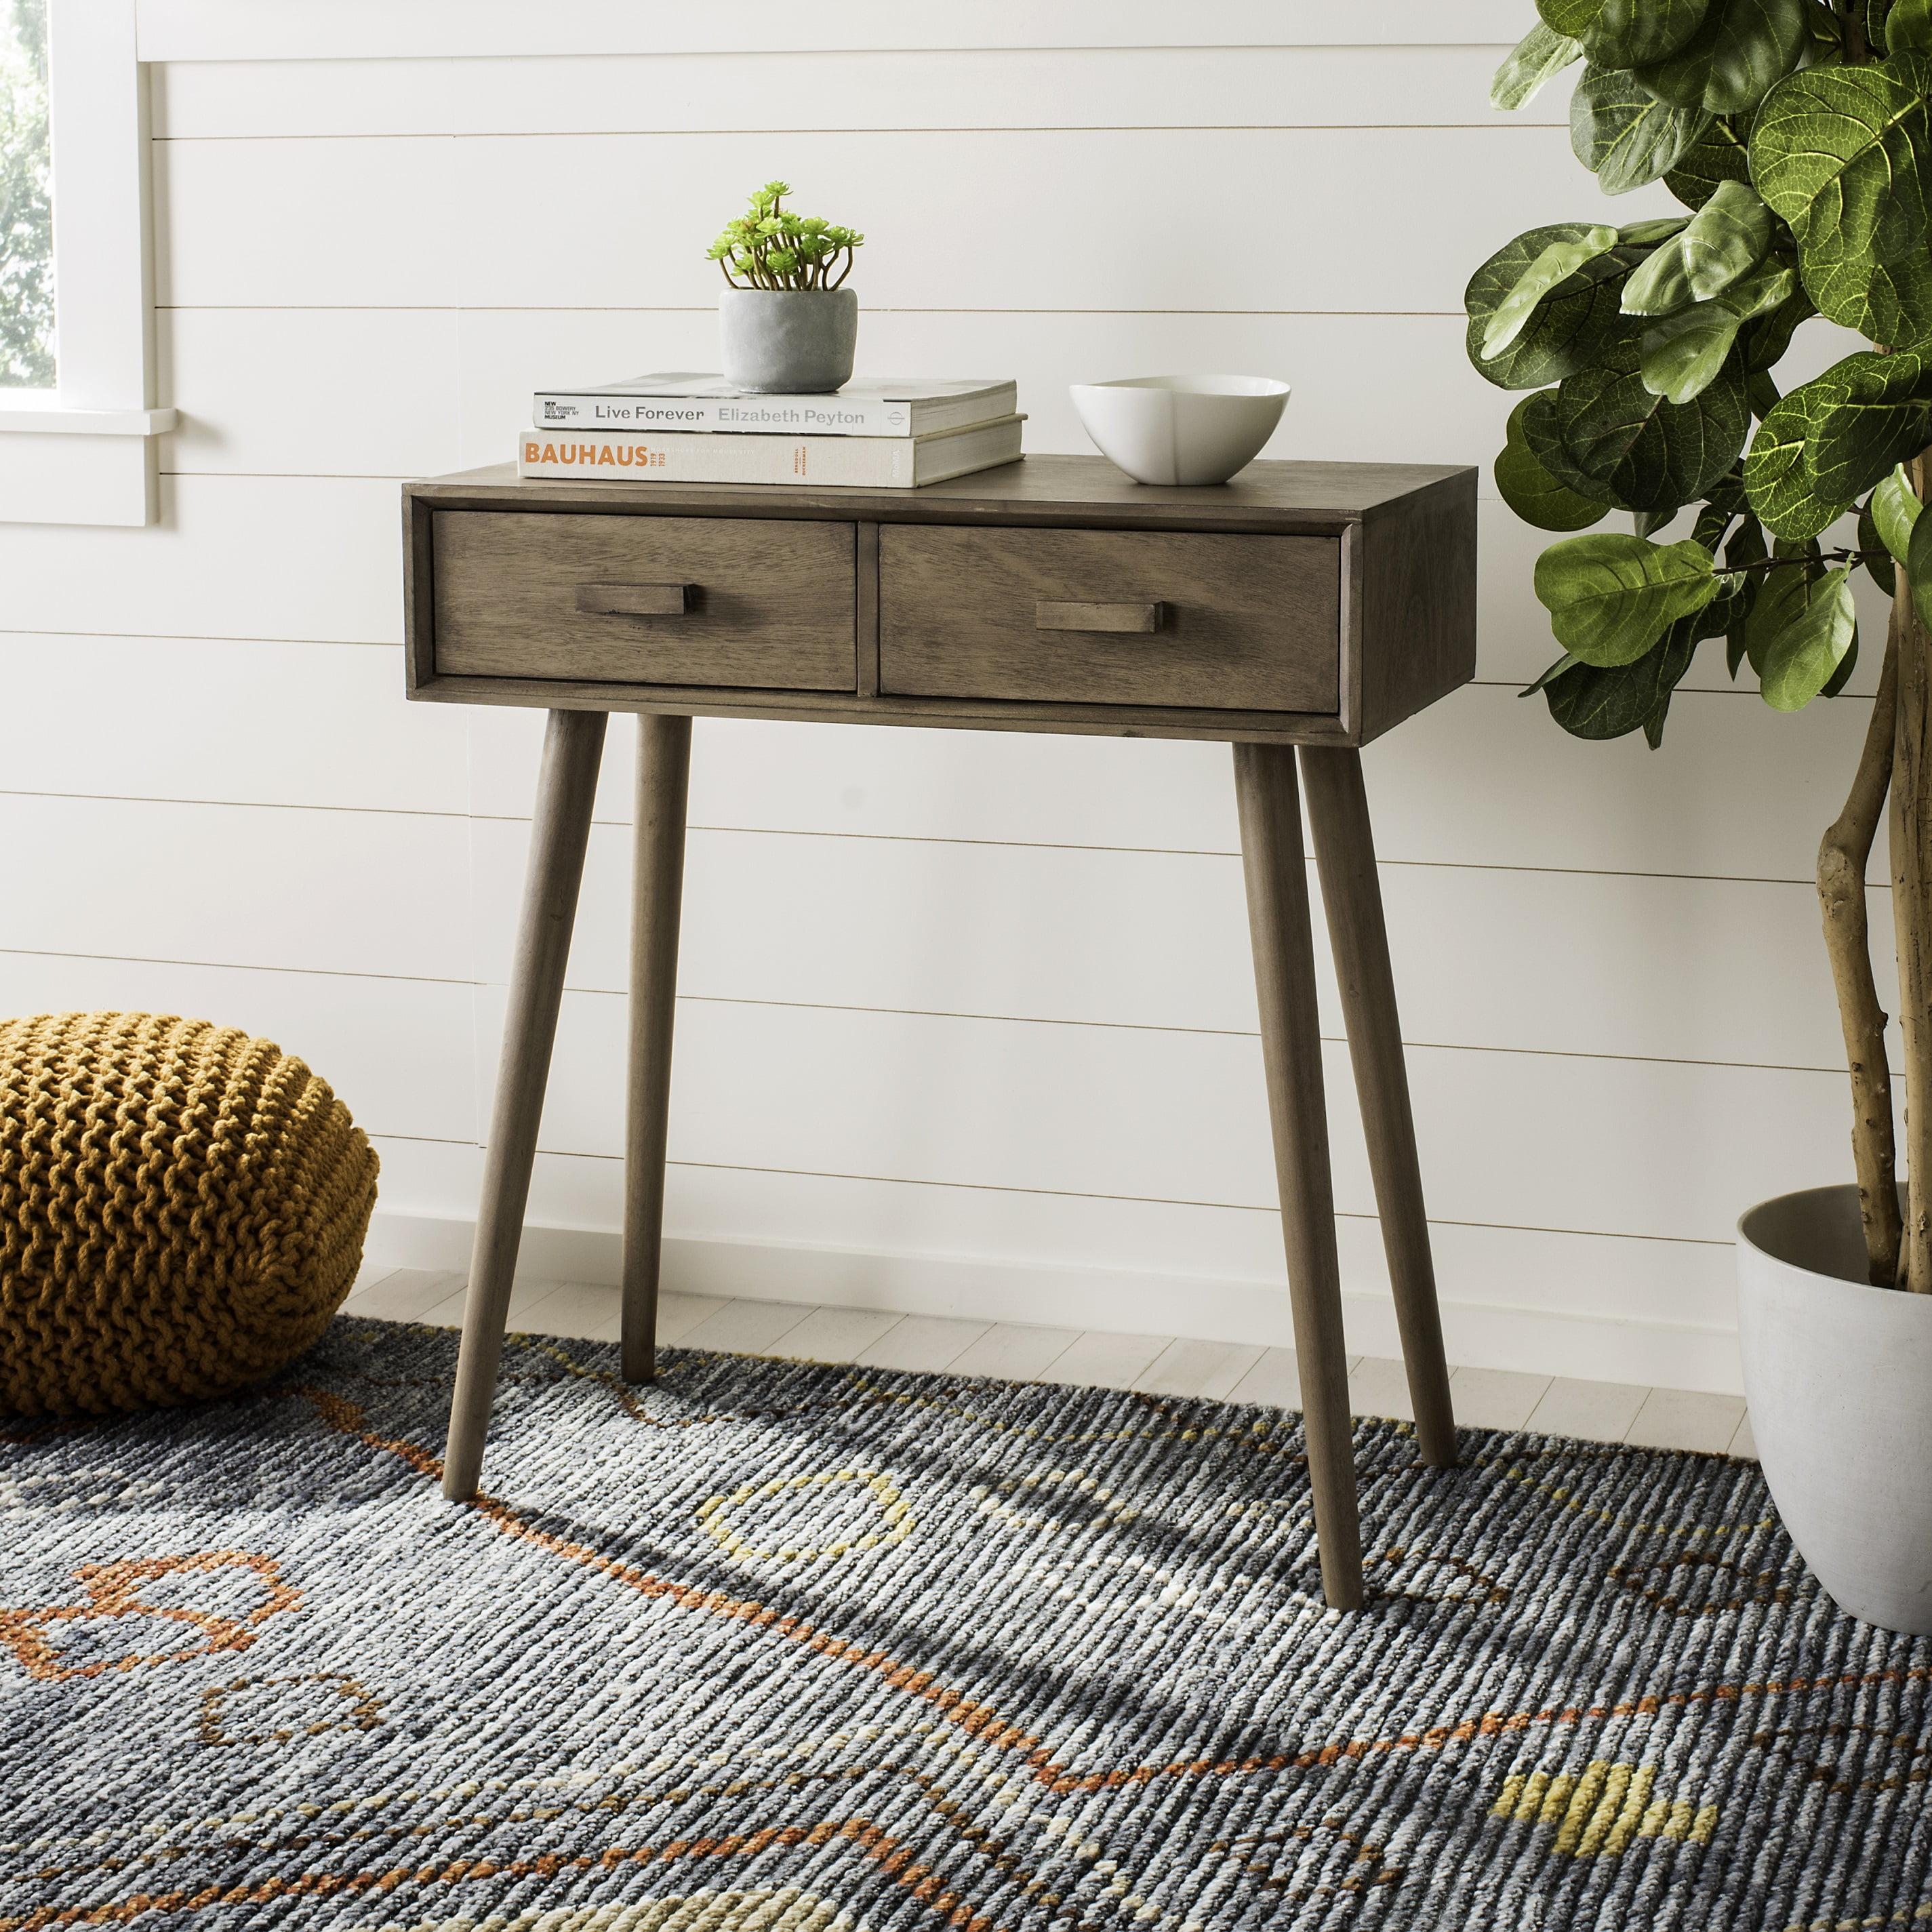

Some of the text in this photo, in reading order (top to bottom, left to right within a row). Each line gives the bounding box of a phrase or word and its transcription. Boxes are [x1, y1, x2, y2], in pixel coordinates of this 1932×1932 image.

[596, 406, 864, 426] Live Forever Elizabeth Peyton
[525, 443, 648, 467] BAUHAUS
[891, 450, 900, 478] MoMA
